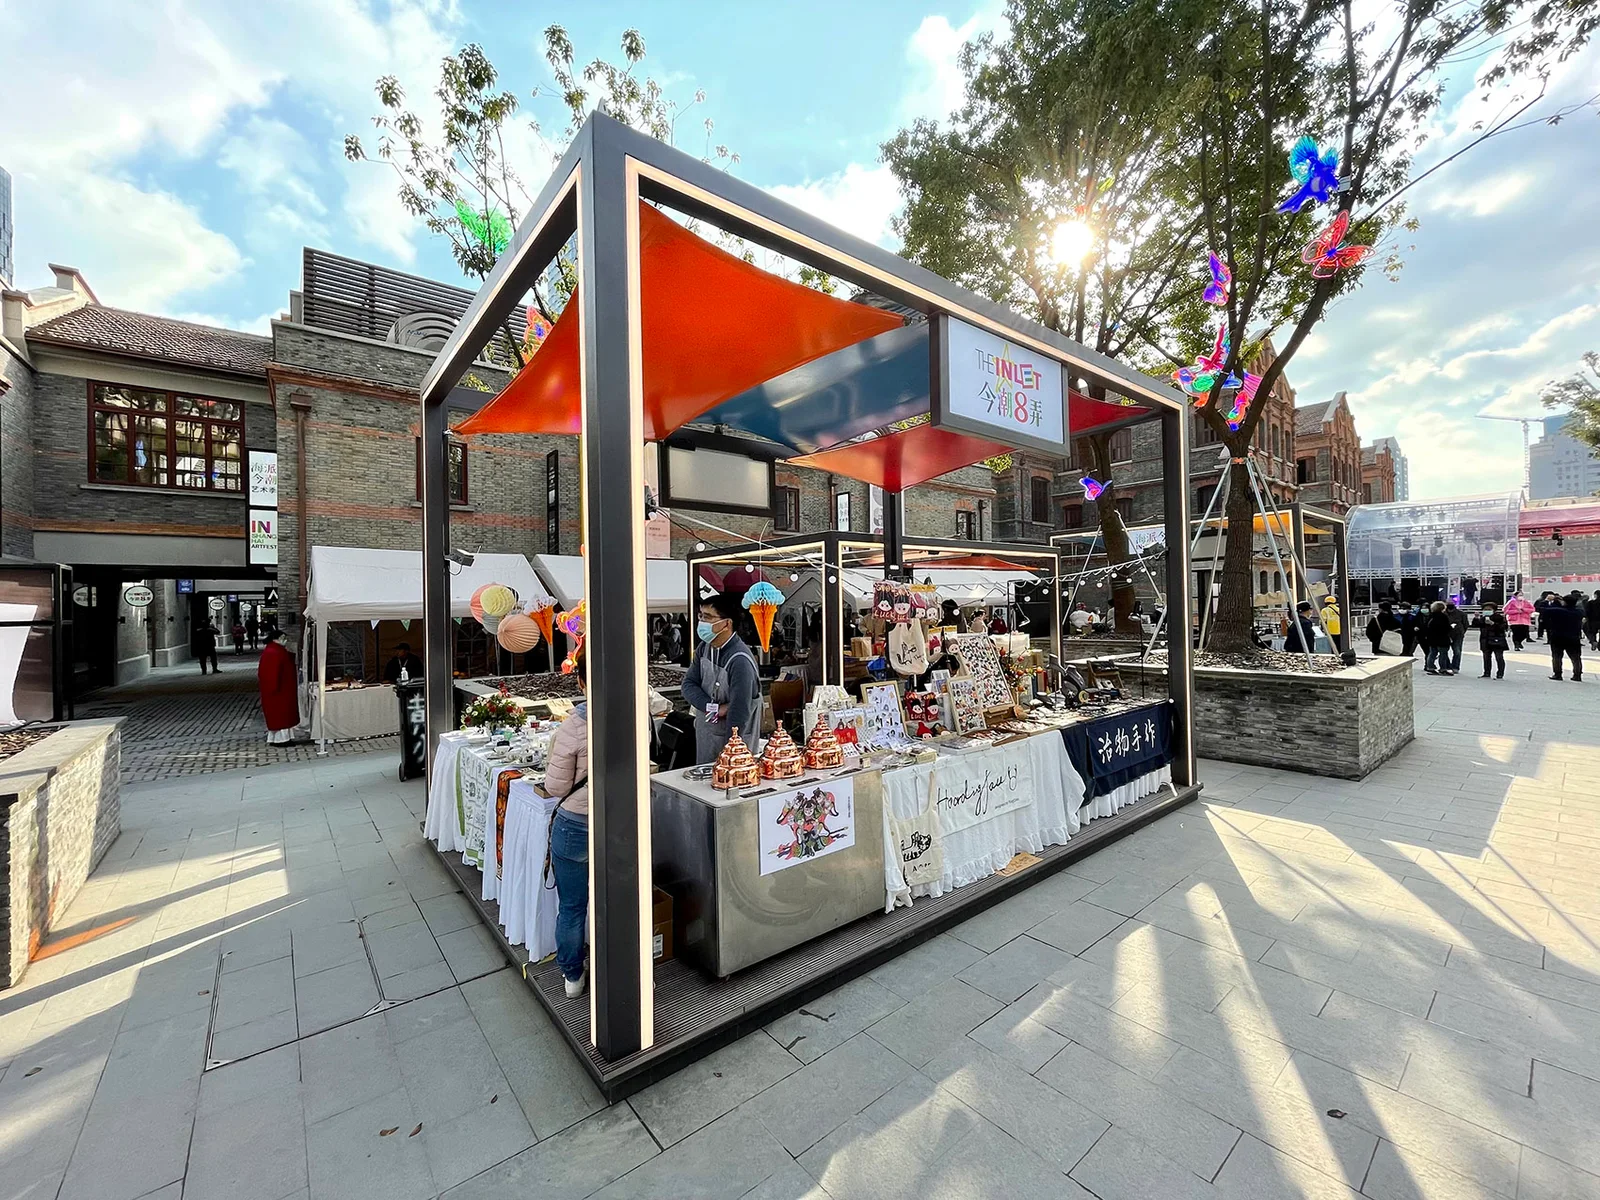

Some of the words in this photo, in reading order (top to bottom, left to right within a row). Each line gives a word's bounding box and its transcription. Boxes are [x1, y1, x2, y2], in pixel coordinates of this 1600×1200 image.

[975, 348, 994, 375] THE
[995, 356, 1042, 390] INLET
[978, 381, 1042, 427] 今潮8弄
[251, 520, 271, 534] IN
